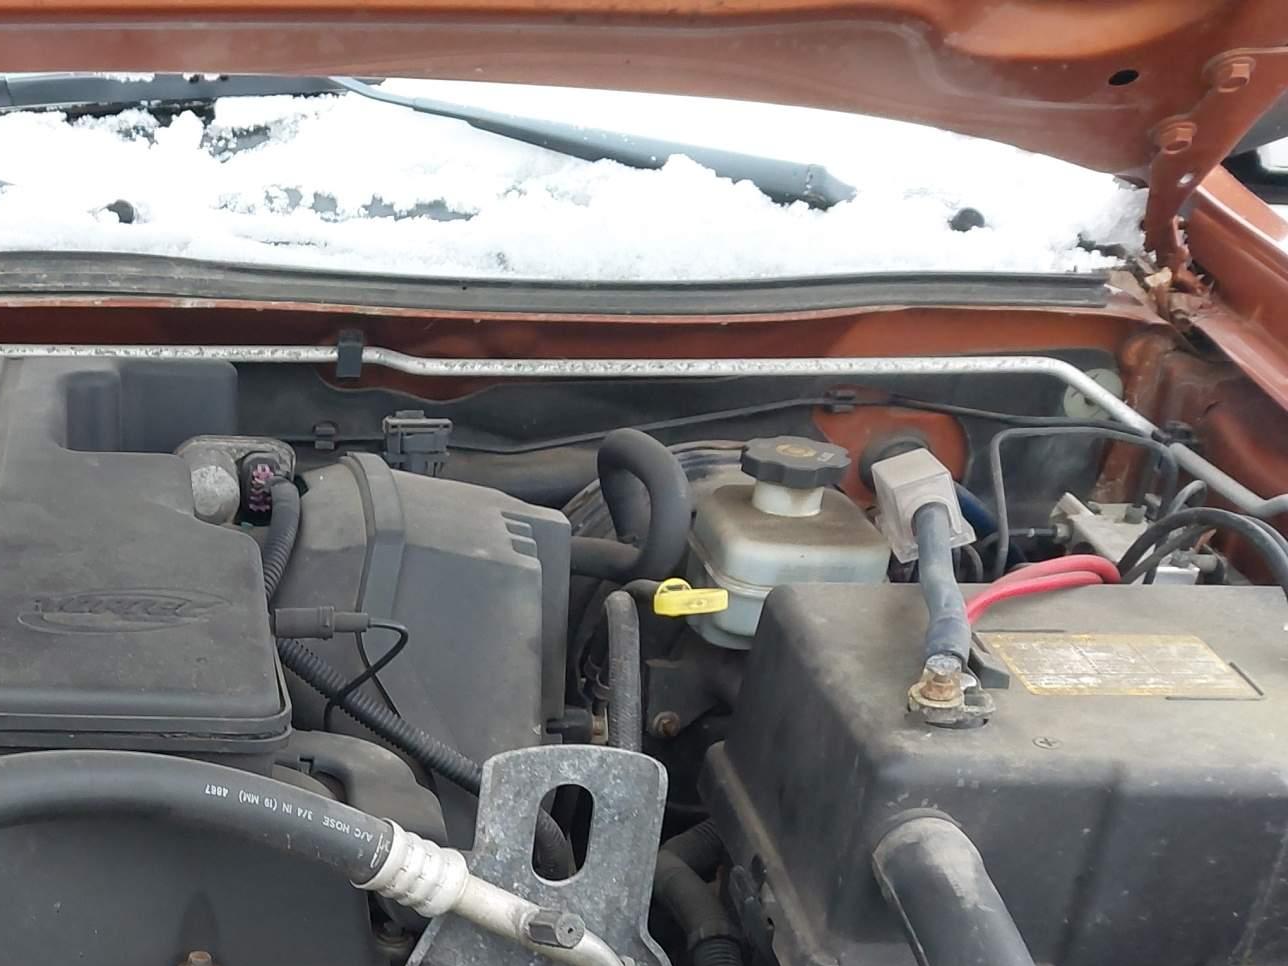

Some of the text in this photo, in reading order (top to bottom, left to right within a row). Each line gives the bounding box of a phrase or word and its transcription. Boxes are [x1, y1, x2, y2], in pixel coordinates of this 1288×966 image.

[238, 789, 260, 805] MM)
[282, 803, 293, 815] IN
[297, 807, 313, 821] 3/4
[322, 815, 350, 834] HOSE
[354, 827, 374, 843] A/C
